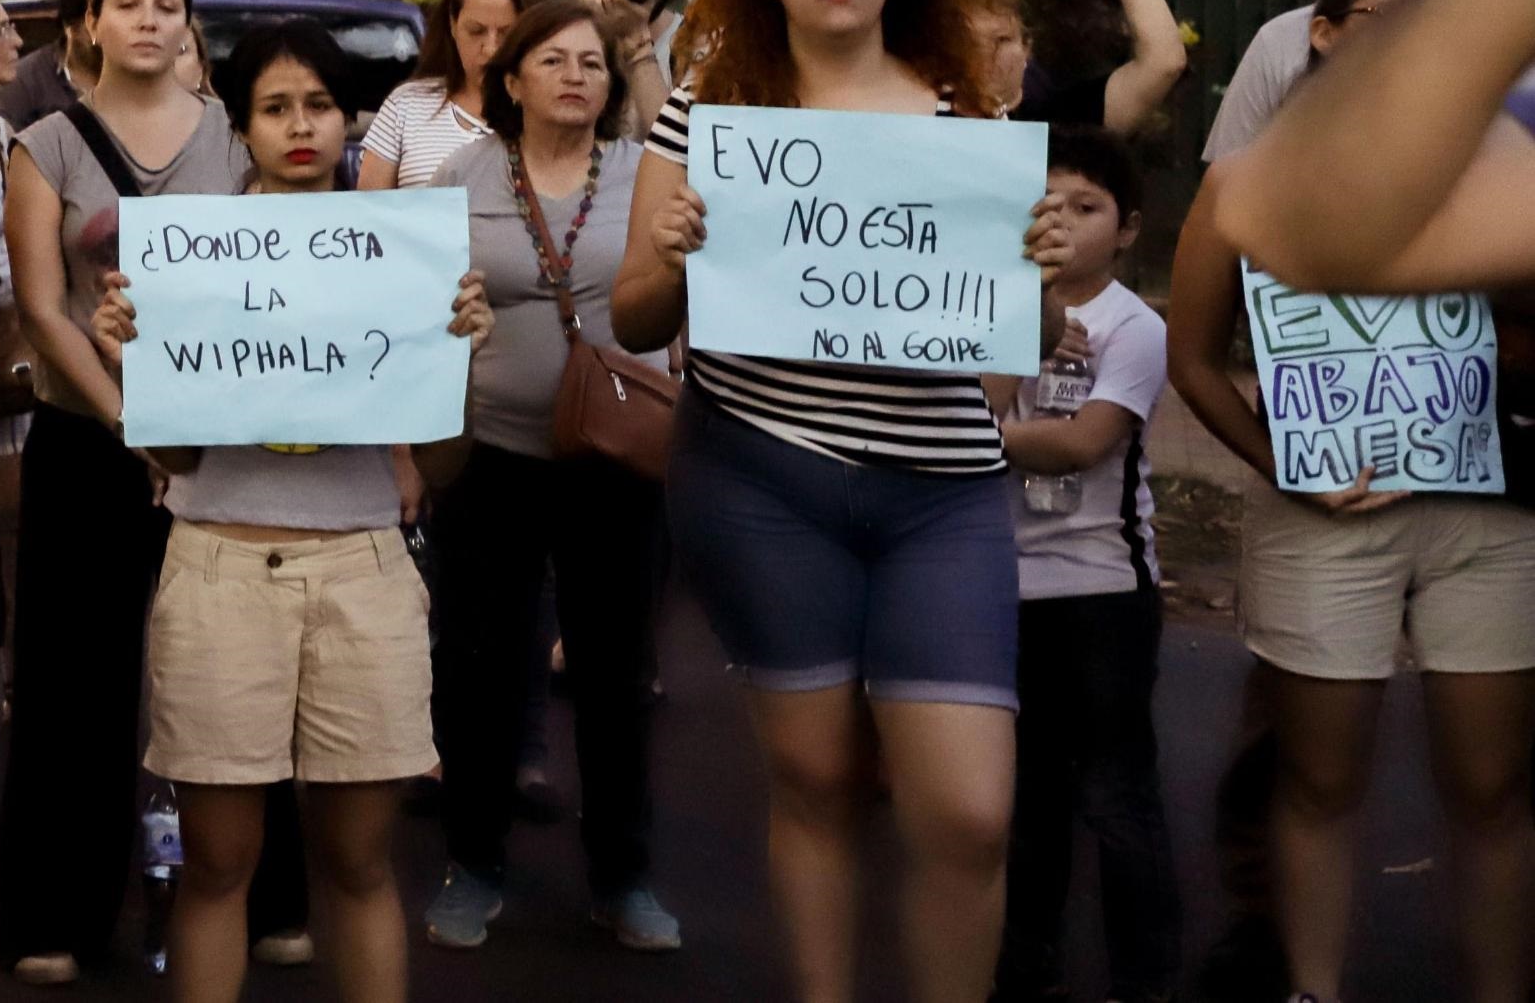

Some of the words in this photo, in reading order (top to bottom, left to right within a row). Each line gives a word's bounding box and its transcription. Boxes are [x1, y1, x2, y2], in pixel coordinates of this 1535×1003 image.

[711, 123, 822, 188] EVO
[141, 224, 290, 271] ¿DONDE
[308, 227, 384, 262] ESTA
[782, 195, 849, 248] NO
[858, 202, 938, 255] ESTA
[244, 280, 287, 312] LA
[800, 265, 995, 333] SOLO!!!!
[1252, 281, 1483, 354] EVO
[812, 328, 849, 359] NO
[863, 330, 887, 363] AL
[1272, 351, 1491, 425] ABAJO
[1284, 418, 1492, 485] MESA
